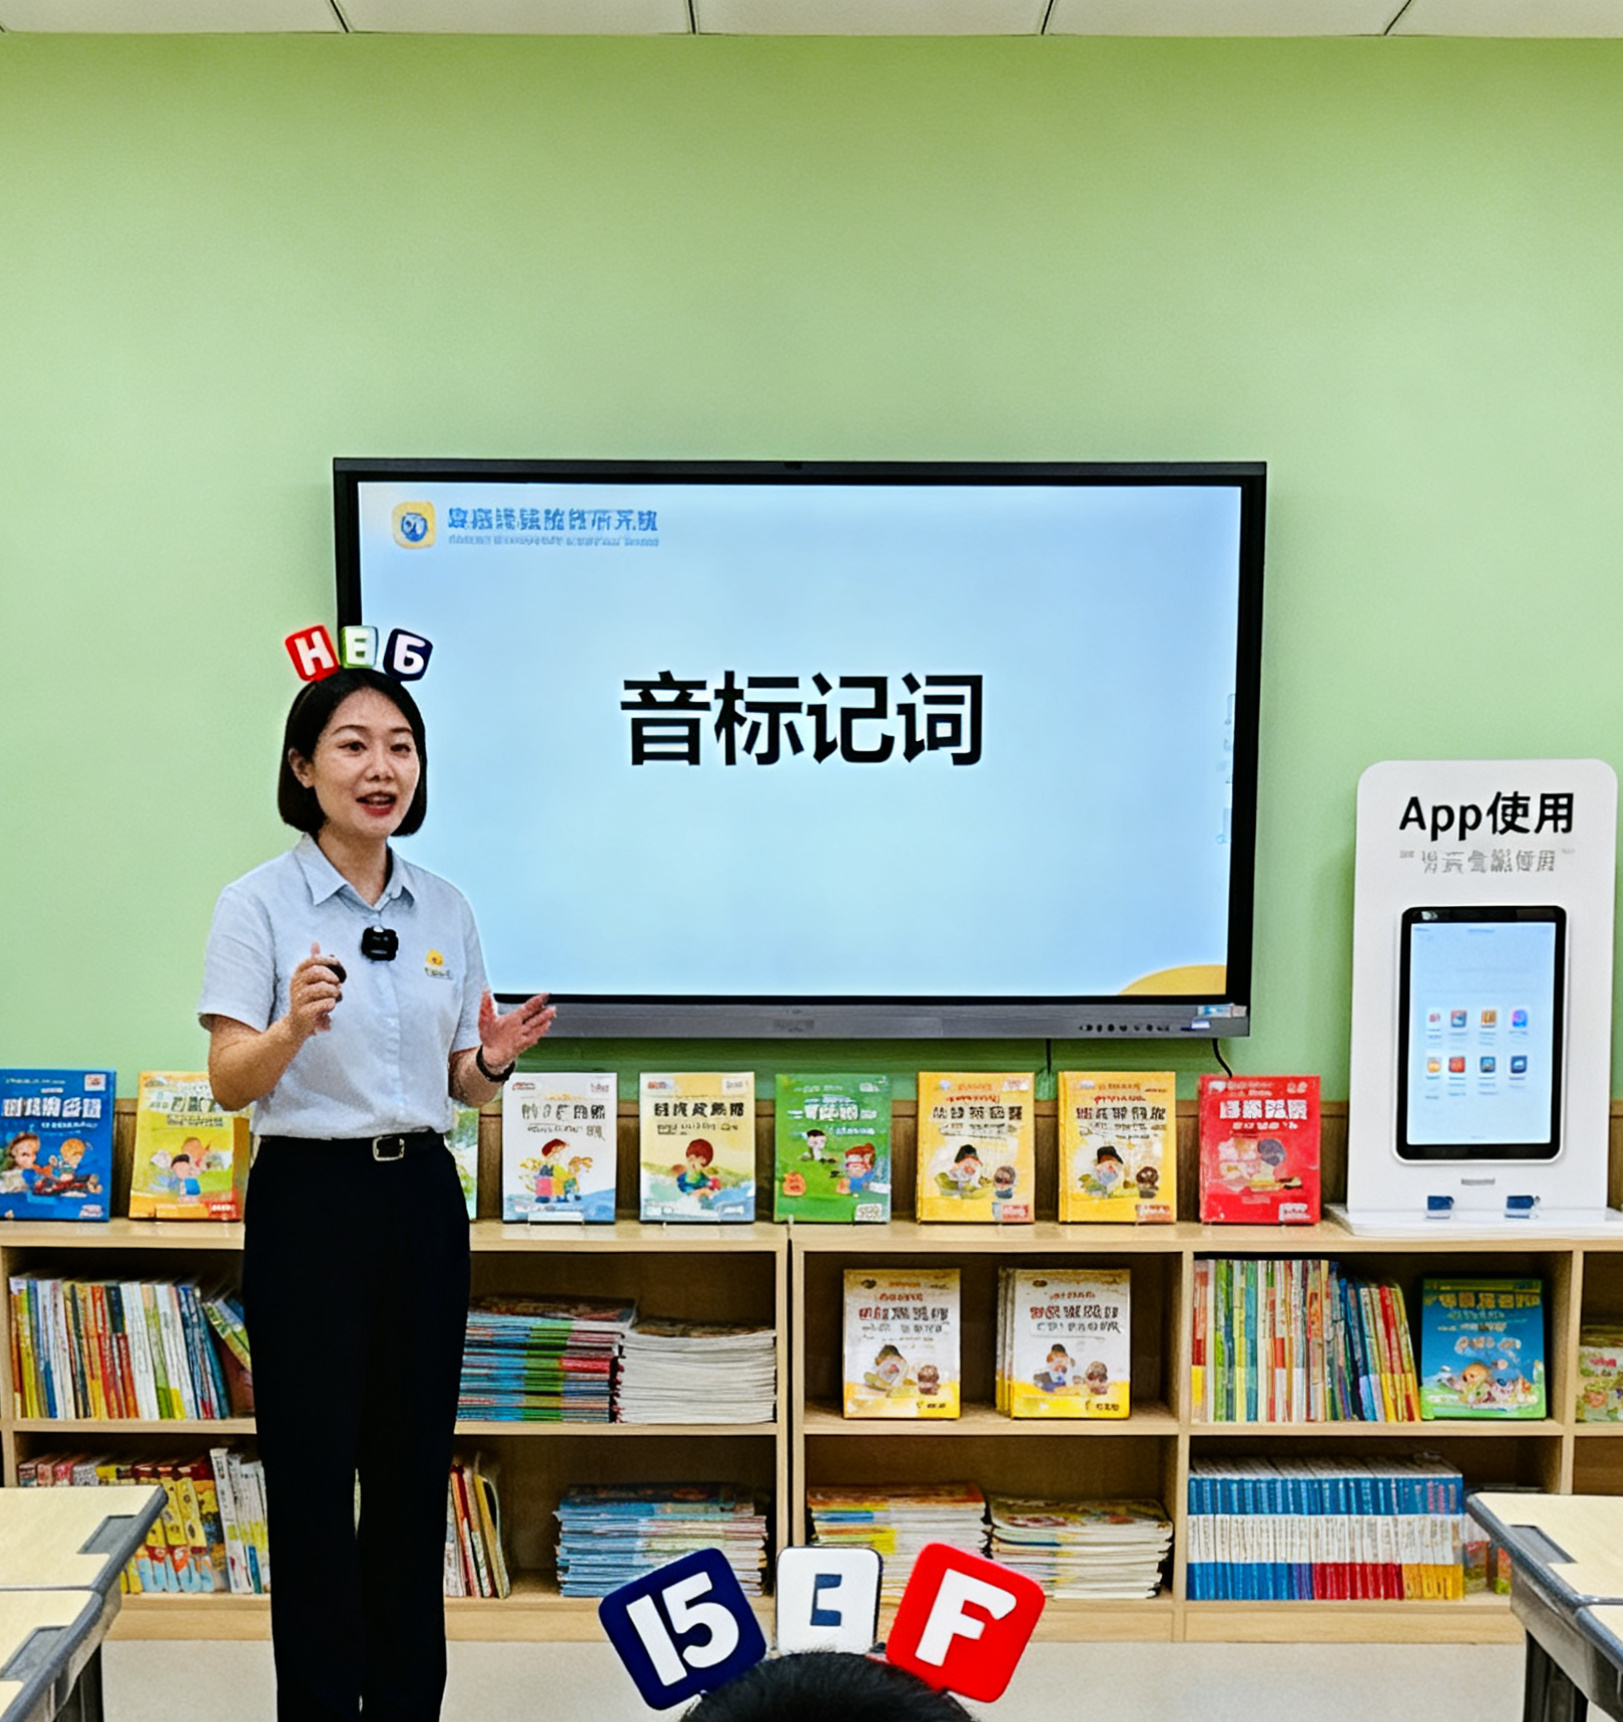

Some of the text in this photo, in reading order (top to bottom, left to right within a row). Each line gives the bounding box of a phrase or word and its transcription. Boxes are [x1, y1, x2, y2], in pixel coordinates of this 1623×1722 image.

[619, 670, 984, 767] 音标记词
[1398, 790, 1576, 842] App使用
[914, 1567, 1018, 1668] F
